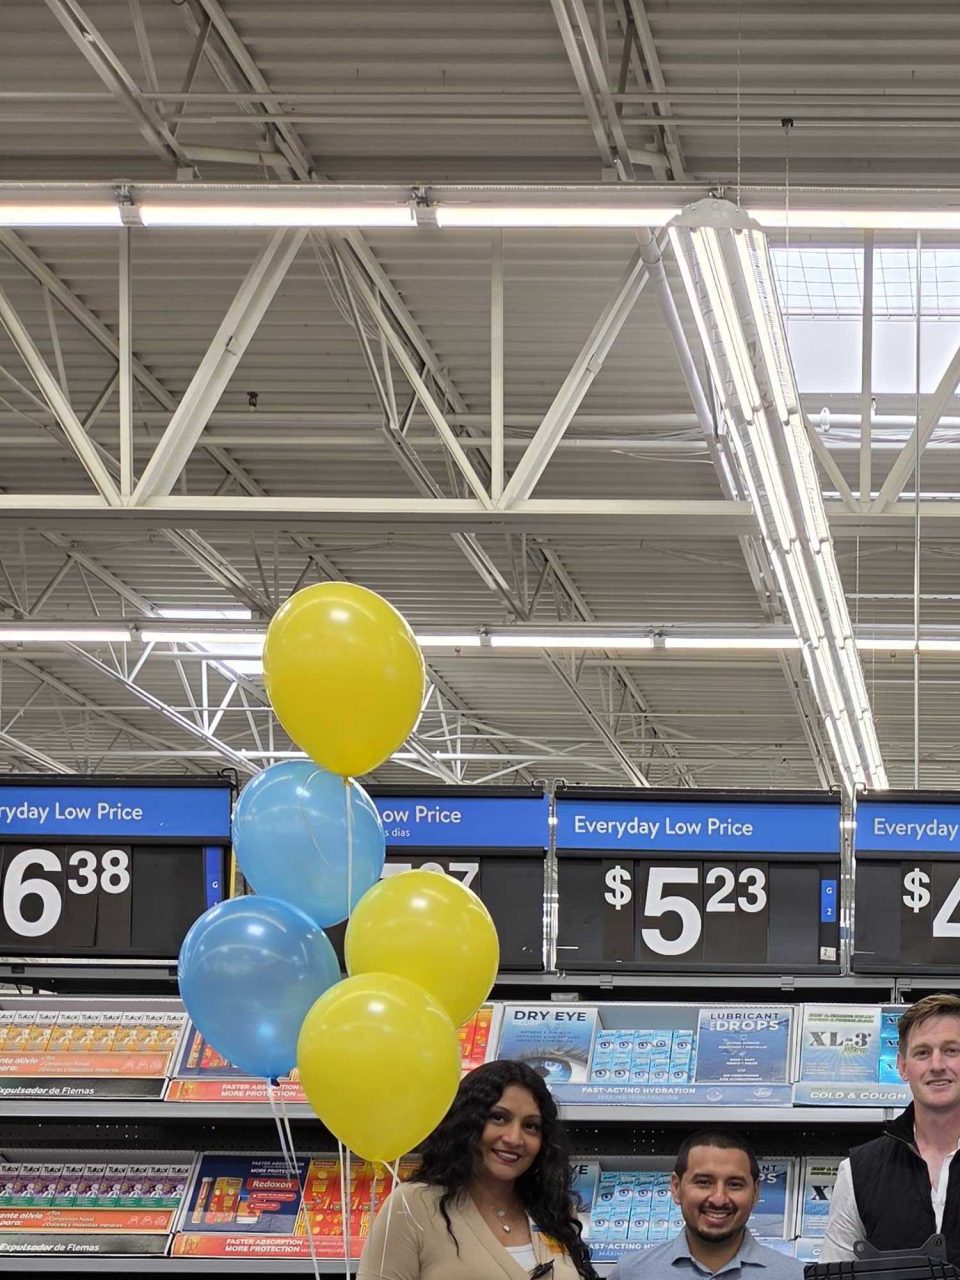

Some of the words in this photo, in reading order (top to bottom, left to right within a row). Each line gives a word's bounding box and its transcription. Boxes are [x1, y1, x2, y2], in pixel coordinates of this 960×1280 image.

[55, 803, 91, 819] Low
[98, 803, 143, 820] Price
[380, 810, 409, 823] ow
[416, 805, 462, 823] Price
[574, 816, 660, 840] Everyday
[666, 817, 701, 835] Low
[708, 818, 753, 836] Price
[874, 818, 958, 841] Everyday
[514, 1011, 550, 1020] DRY
[555, 1012, 586, 1021] EYE
[716, 1020, 779, 1031] DROPS
[62, 1087, 95, 1095] Flemas
[253, 1180, 292, 1188] Redoxon
[67, 1243, 99, 1251] Flemas
